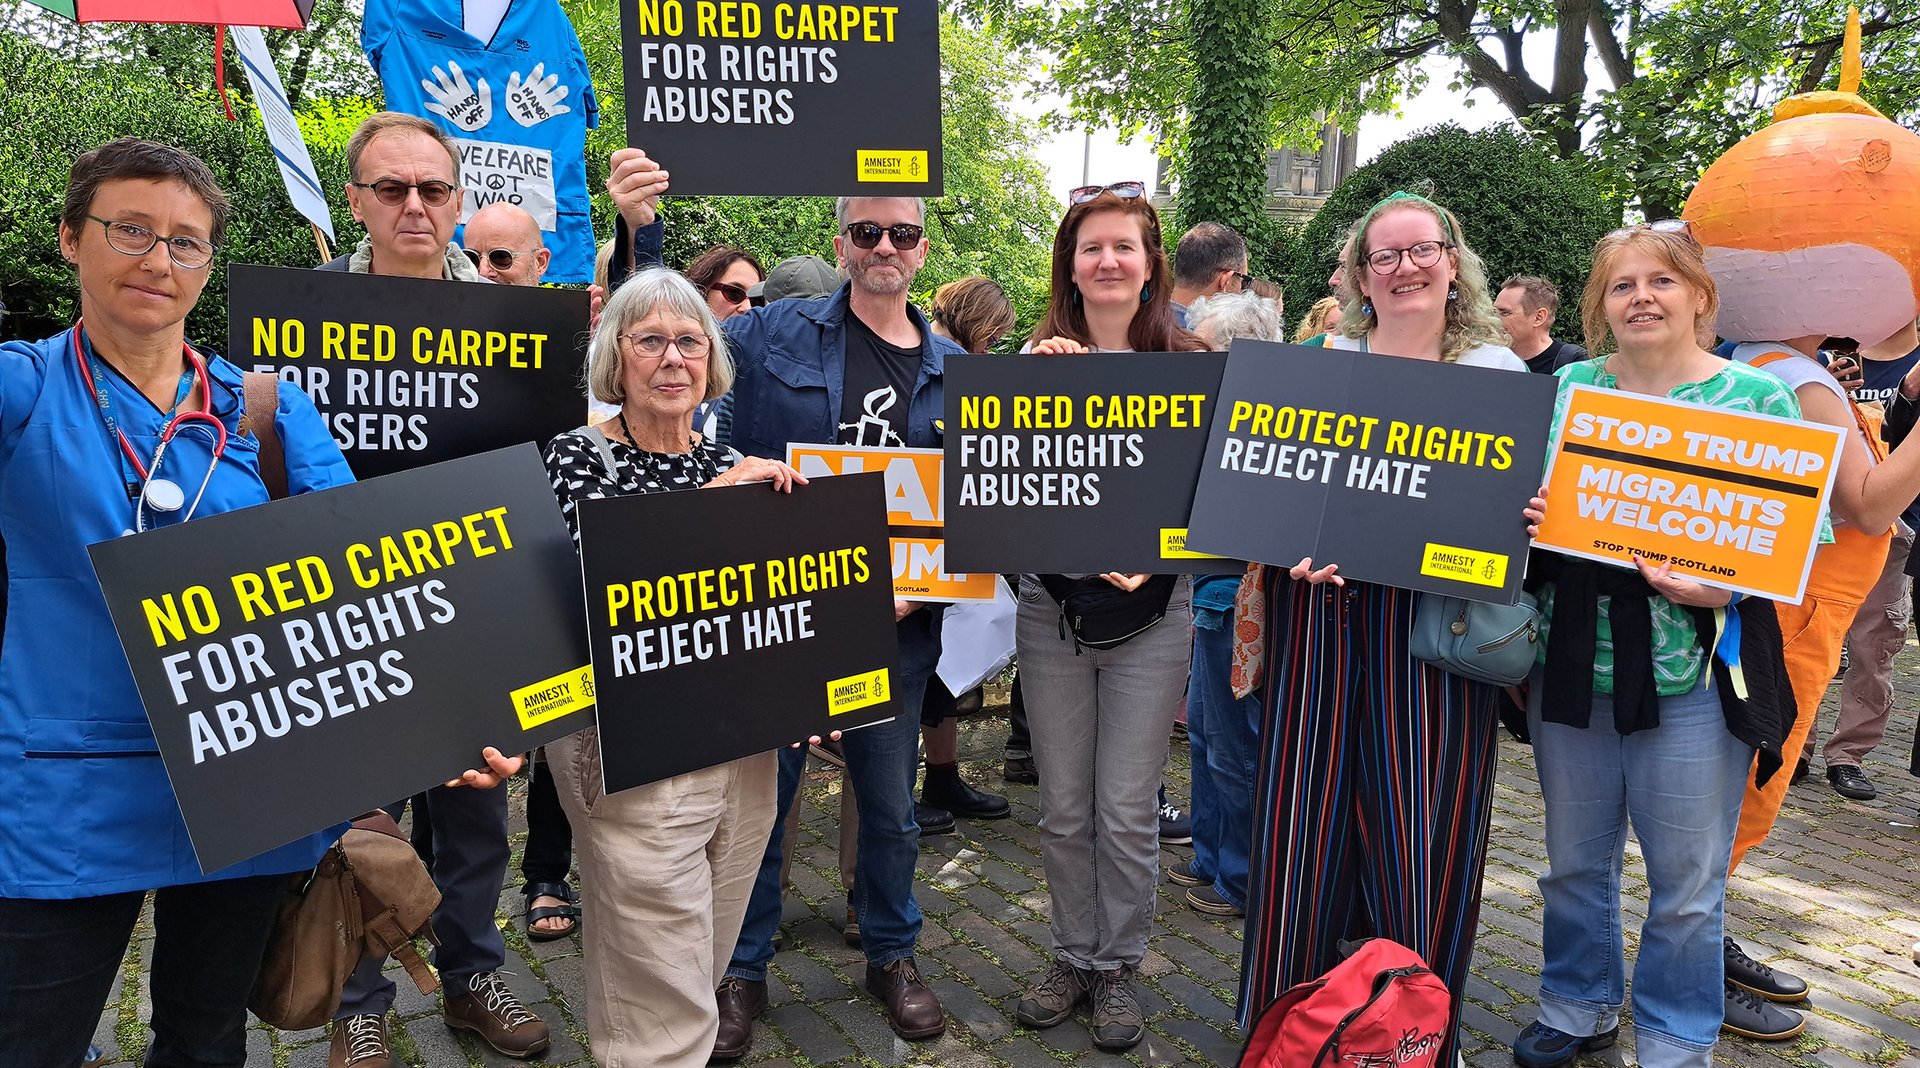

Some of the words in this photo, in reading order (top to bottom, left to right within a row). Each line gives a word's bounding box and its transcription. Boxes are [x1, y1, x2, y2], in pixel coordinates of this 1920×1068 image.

[638, 0, 684, 38] NO
[696, 1, 761, 40] RED
[774, 3, 899, 43] CARPET
[641, 42, 708, 81] FOR
[719, 45, 838, 84] RIGHTS
[447, 94, 479, 120] HANDS
[465, 105, 484, 125] OFF
[511, 93, 534, 119] OFF
[522, 87, 550, 120] HANDS
[643, 86, 795, 125] ABUSERS
[864, 157, 902, 167] AMNESTY
[253, 317, 305, 358] NO
[322, 321, 396, 362] RED
[412, 326, 549, 369] CARPET
[346, 368, 480, 409] RIGHTS
[961, 396, 1001, 429] NO
[1013, 395, 1073, 429] RED
[1085, 395, 1206, 429] CARPET
[321, 412, 429, 451] SERS
[961, 434, 1021, 468] FOR
[1032, 433, 1144, 468] RIGHTS
[1228, 400, 1379, 451] PROTECT
[1385, 420, 1515, 470] RIGHTS
[1569, 412, 1672, 450] STOP
[1683, 431, 1825, 477] TRUMP
[1219, 437, 1340, 484] REJECT
[1345, 454, 1432, 499] HATE
[959, 472, 1101, 507] ABUSERS
[1577, 464, 1788, 527] MIGRANTS
[1167, 535, 1188, 545] AMN
[1576, 491, 1778, 556] WELCOME
[142, 585, 221, 647] NO
[231, 555, 334, 622] RED
[345, 506, 513, 589] CARPET
[1430, 562, 1473, 576] INTERNATIONAL
[1431, 551, 1476, 568] AMNESTY
[1593, 540, 1624, 553] STOP
[1627, 547, 1668, 562] TRUMP
[1670, 556, 1736, 577] SCOTLAND
[606, 563, 756, 627] PROTECT
[766, 546, 870, 599] RIGHTS
[161, 634, 276, 706] FOR
[281, 579, 456, 669] RIGHTS
[611, 614, 732, 679] REJECT
[741, 599, 816, 651] HATE
[187, 649, 414, 765] ABUSERS
[523, 682, 571, 709] AMNESTY
[526, 696, 575, 719] INTERNATIONAL
[834, 680, 867, 699] AMNESTY
[834, 692, 868, 707] INTERNATIONAL
